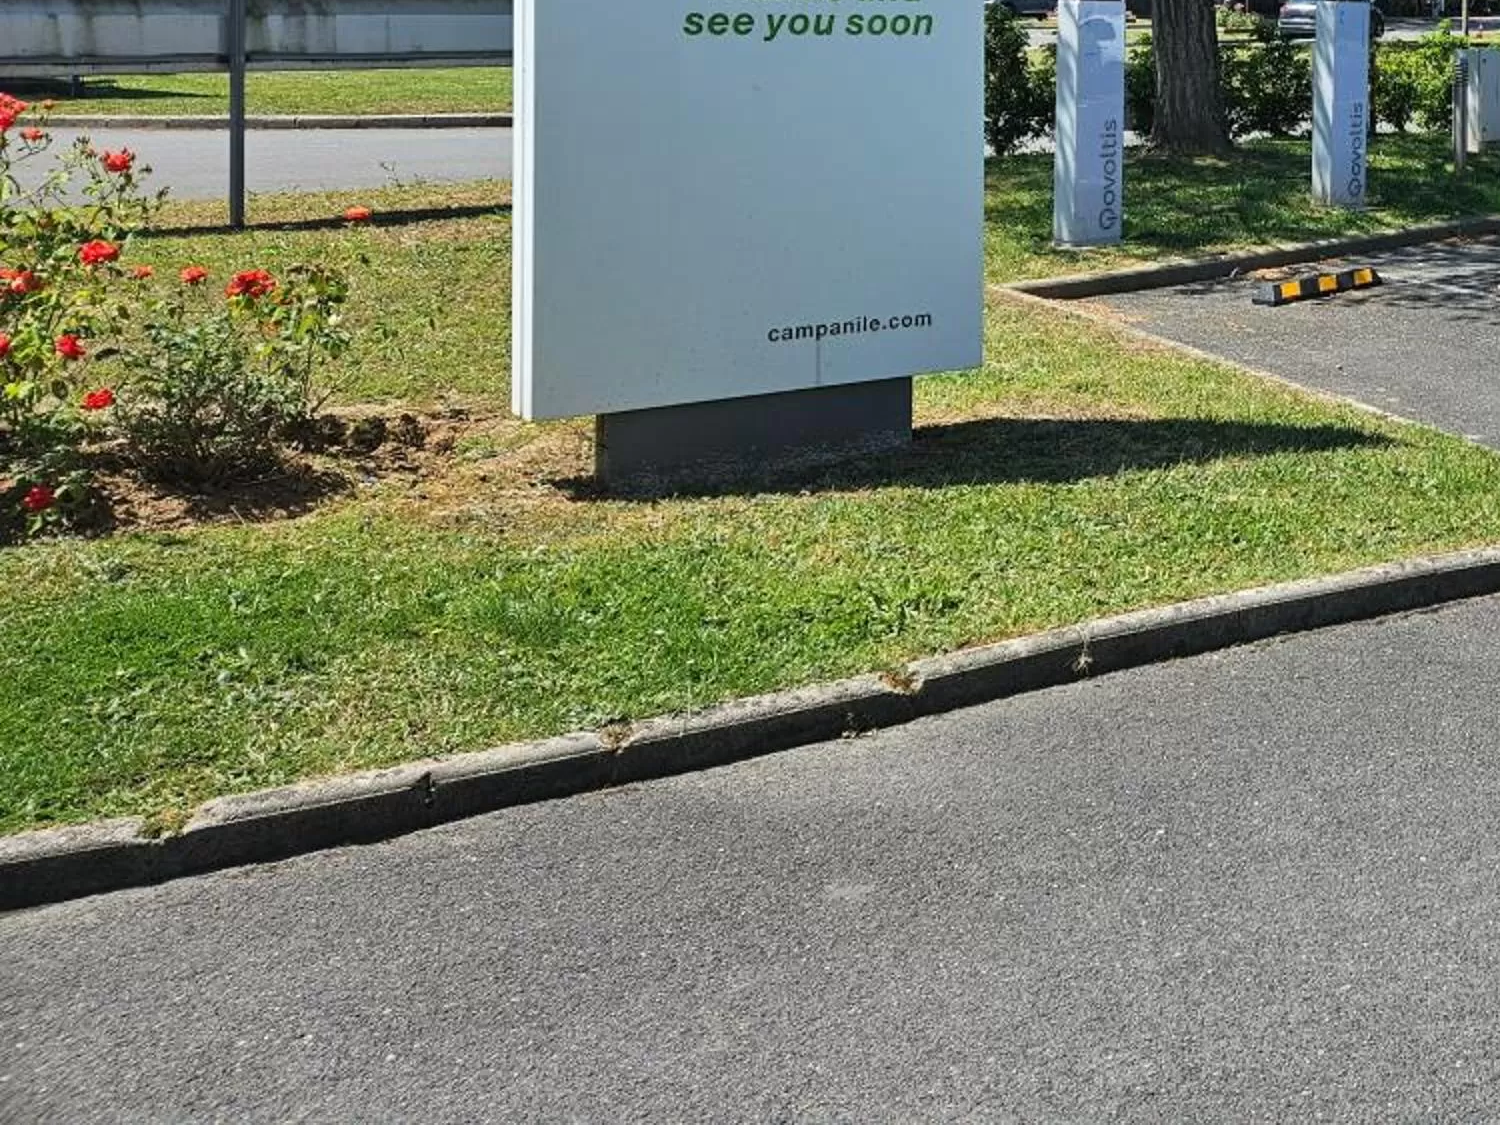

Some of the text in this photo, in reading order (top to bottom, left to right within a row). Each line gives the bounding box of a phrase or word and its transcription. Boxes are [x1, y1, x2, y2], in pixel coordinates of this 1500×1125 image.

[682, 10, 934, 42] see you soon
[1098, 118, 1118, 231] Qovoltis
[767, 310, 933, 343] campanile.com
